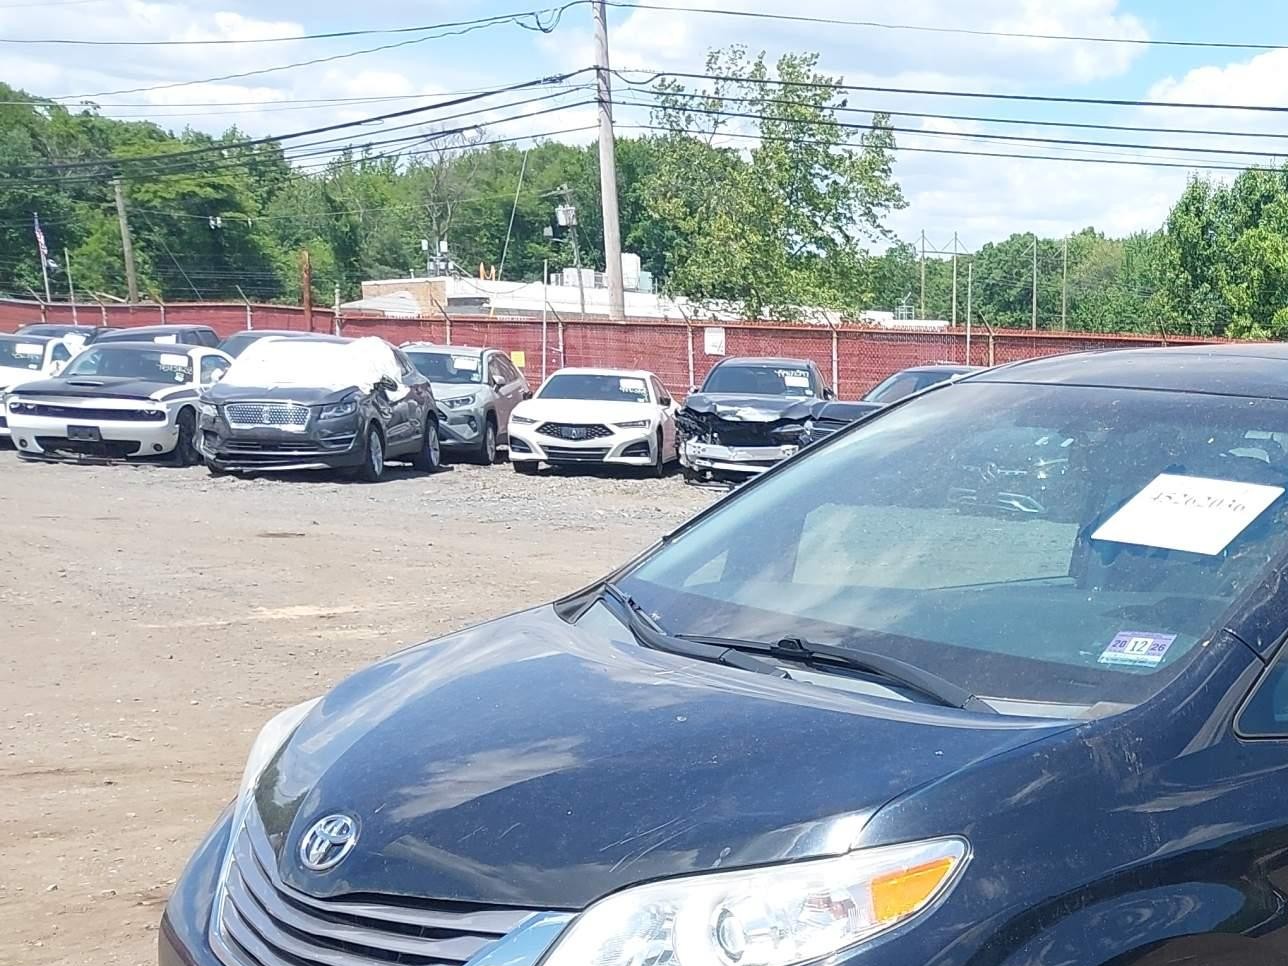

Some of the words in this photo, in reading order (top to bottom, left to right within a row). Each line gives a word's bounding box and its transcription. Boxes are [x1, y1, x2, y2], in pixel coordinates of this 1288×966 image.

[1112, 640, 1128, 648] 20
[1130, 640, 1148, 652] 12
[1150, 643, 1167, 652] 26
